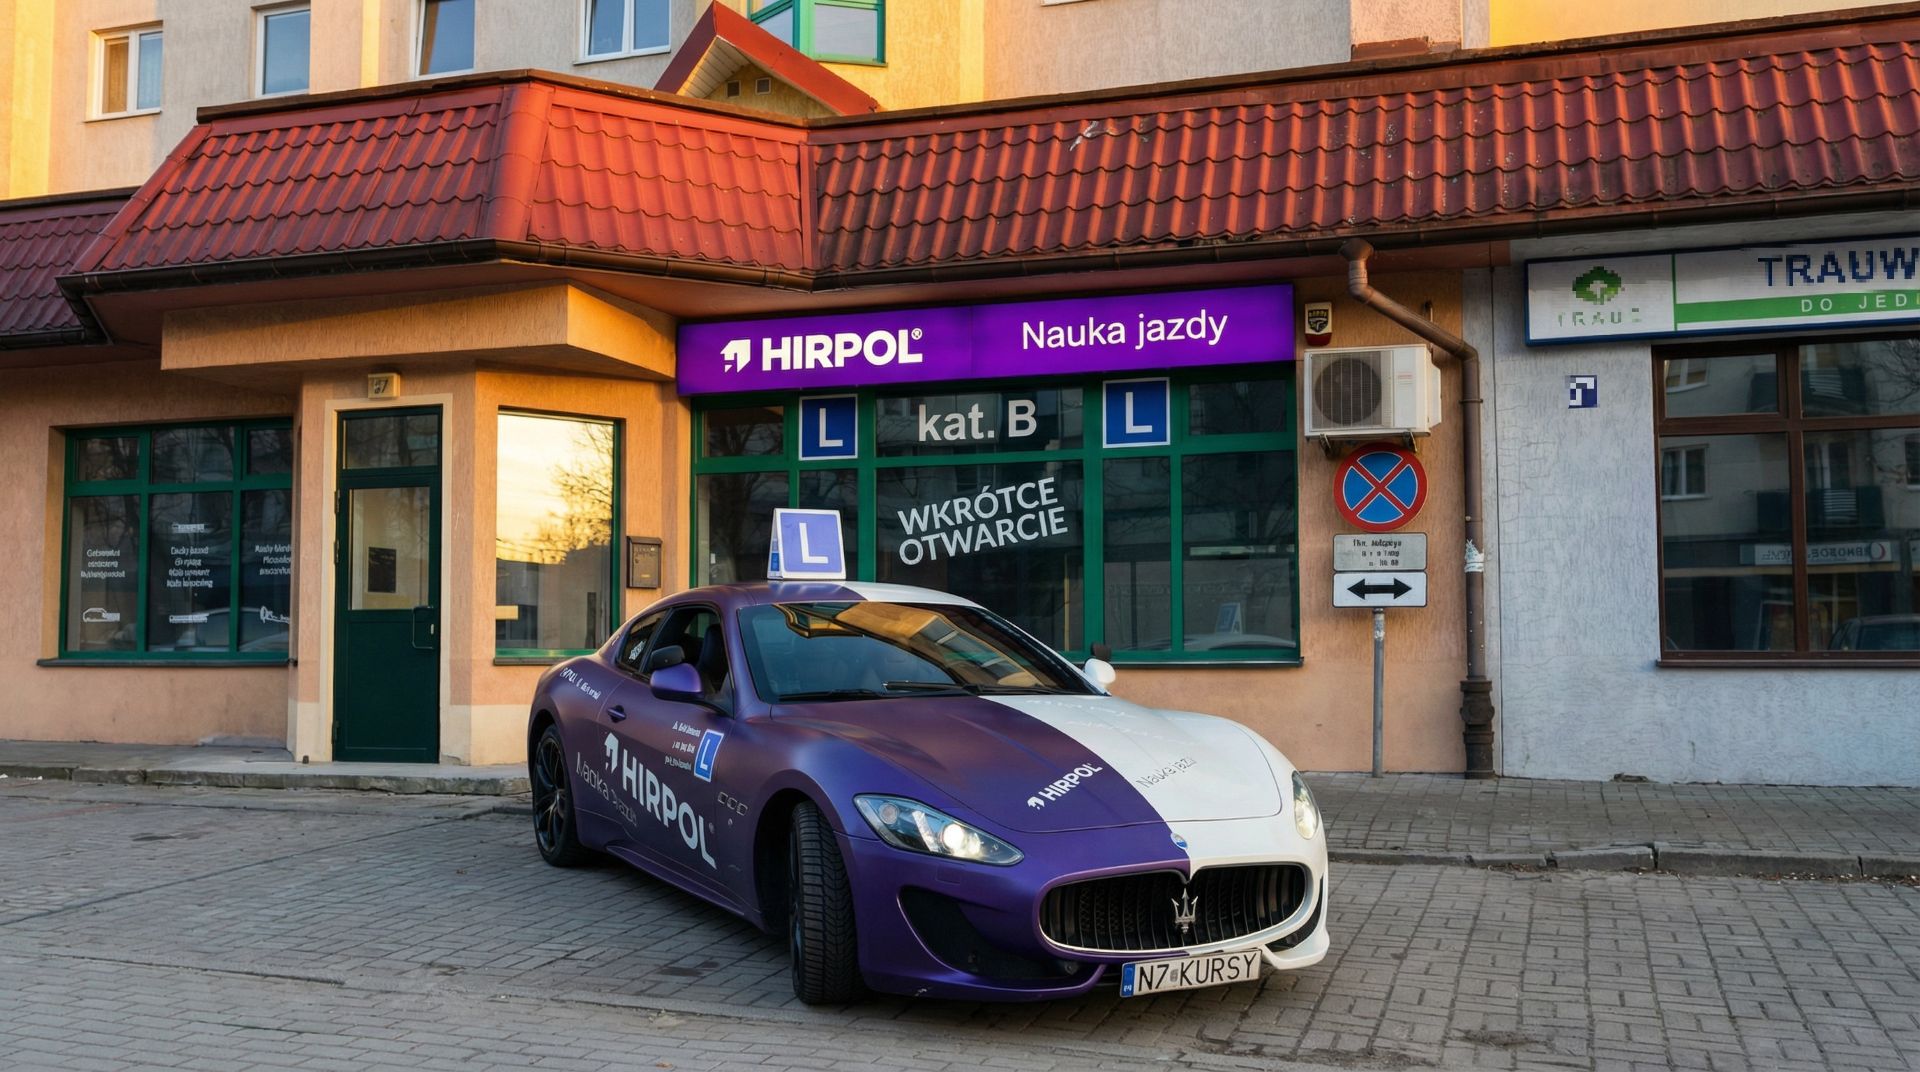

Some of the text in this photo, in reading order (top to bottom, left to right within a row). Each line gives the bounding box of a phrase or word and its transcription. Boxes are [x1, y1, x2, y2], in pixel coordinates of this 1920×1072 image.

[1758, 247, 1919, 286] TRAUW
[1802, 293, 1920, 312] DO JED
[1022, 316, 1126, 350] Nauka
[1135, 308, 1229, 350] jazdy
[819, 407, 844, 447] L
[918, 399, 1037, 442] kat. B
[1125, 391, 1153, 434] L
[897, 476, 1058, 535] WKRÓTCE
[799, 522, 828, 564] L
[899, 505, 1068, 566] OTWARCIE
[700, 739, 711, 771] L
[1180, 952, 1257, 987] KURSY
